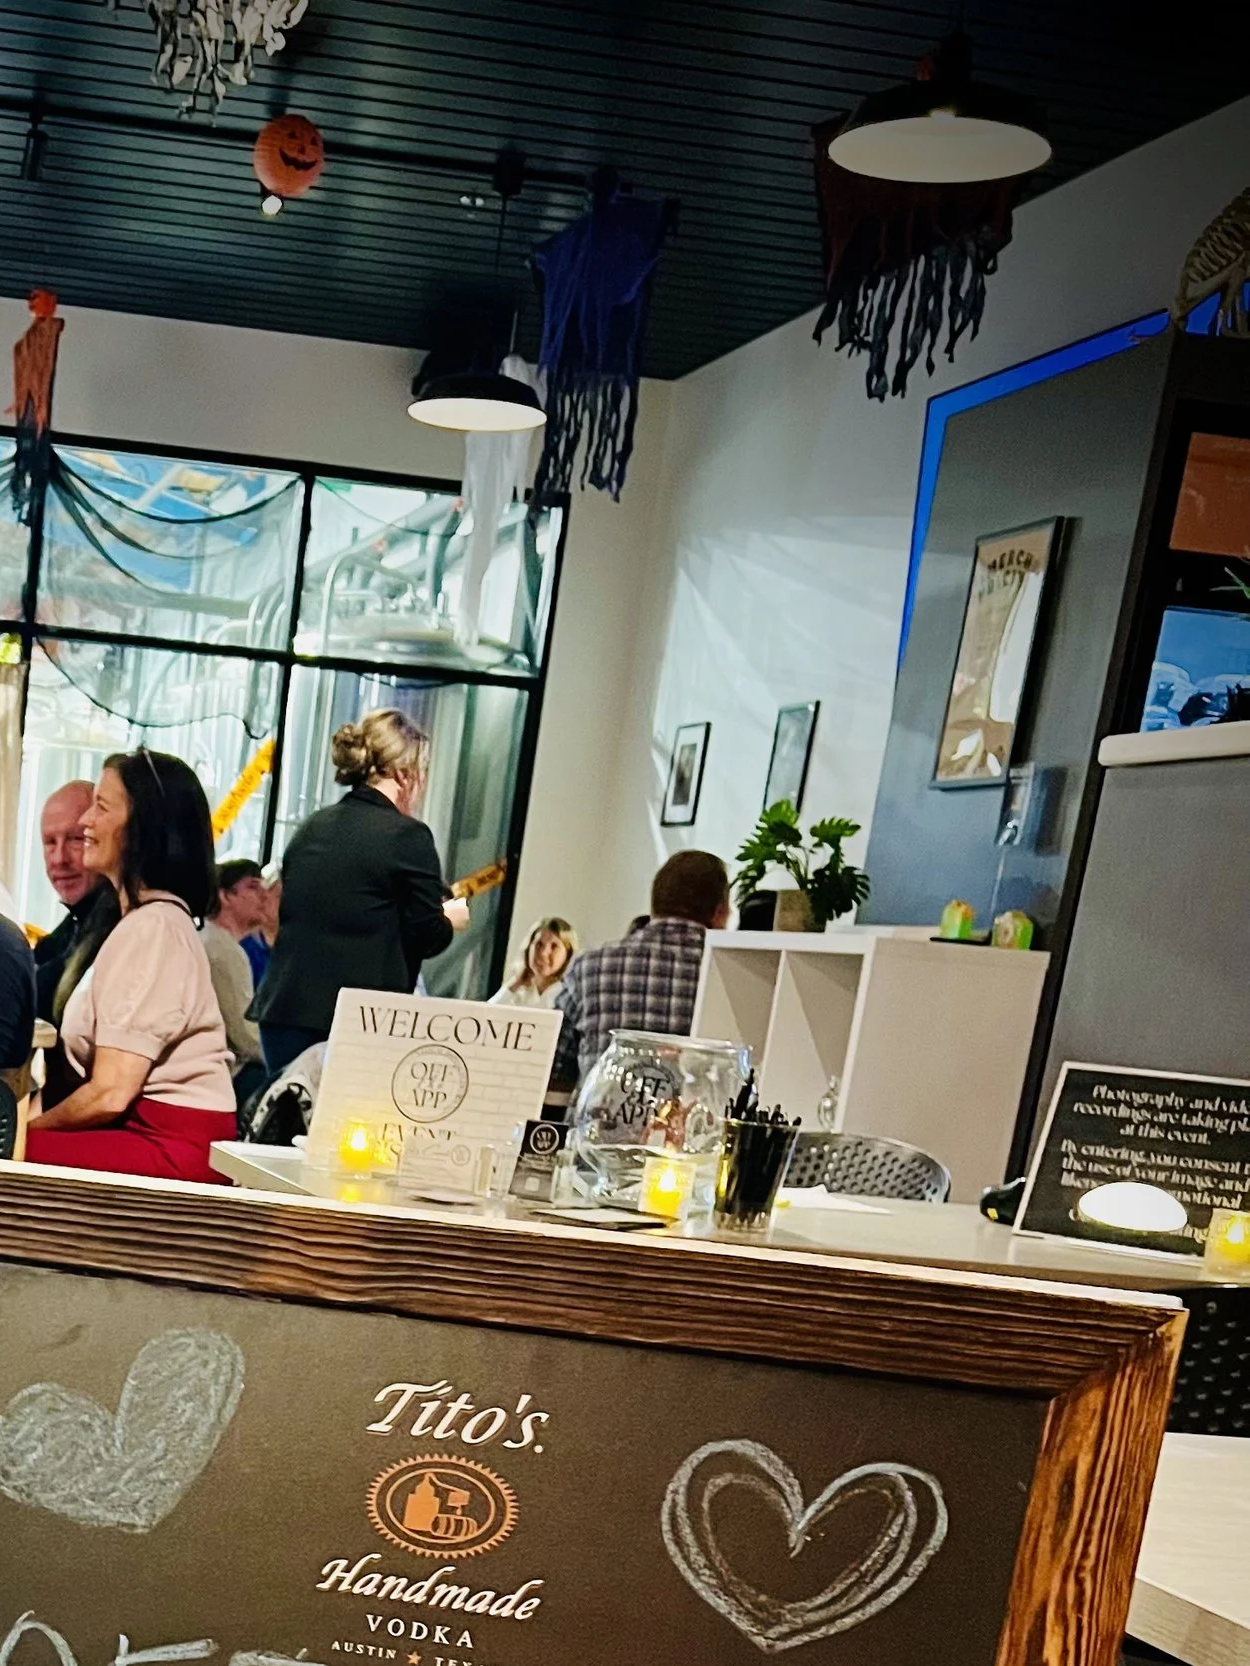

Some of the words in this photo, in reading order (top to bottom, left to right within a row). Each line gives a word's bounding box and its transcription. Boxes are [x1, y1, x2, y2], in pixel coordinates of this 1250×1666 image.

[358, 1005, 536, 1052] WELCOME
[315, 1553, 545, 1621] Handmade
[330, 1640, 398, 1660] AUSTIN
[365, 1614, 475, 1650] VODKA
